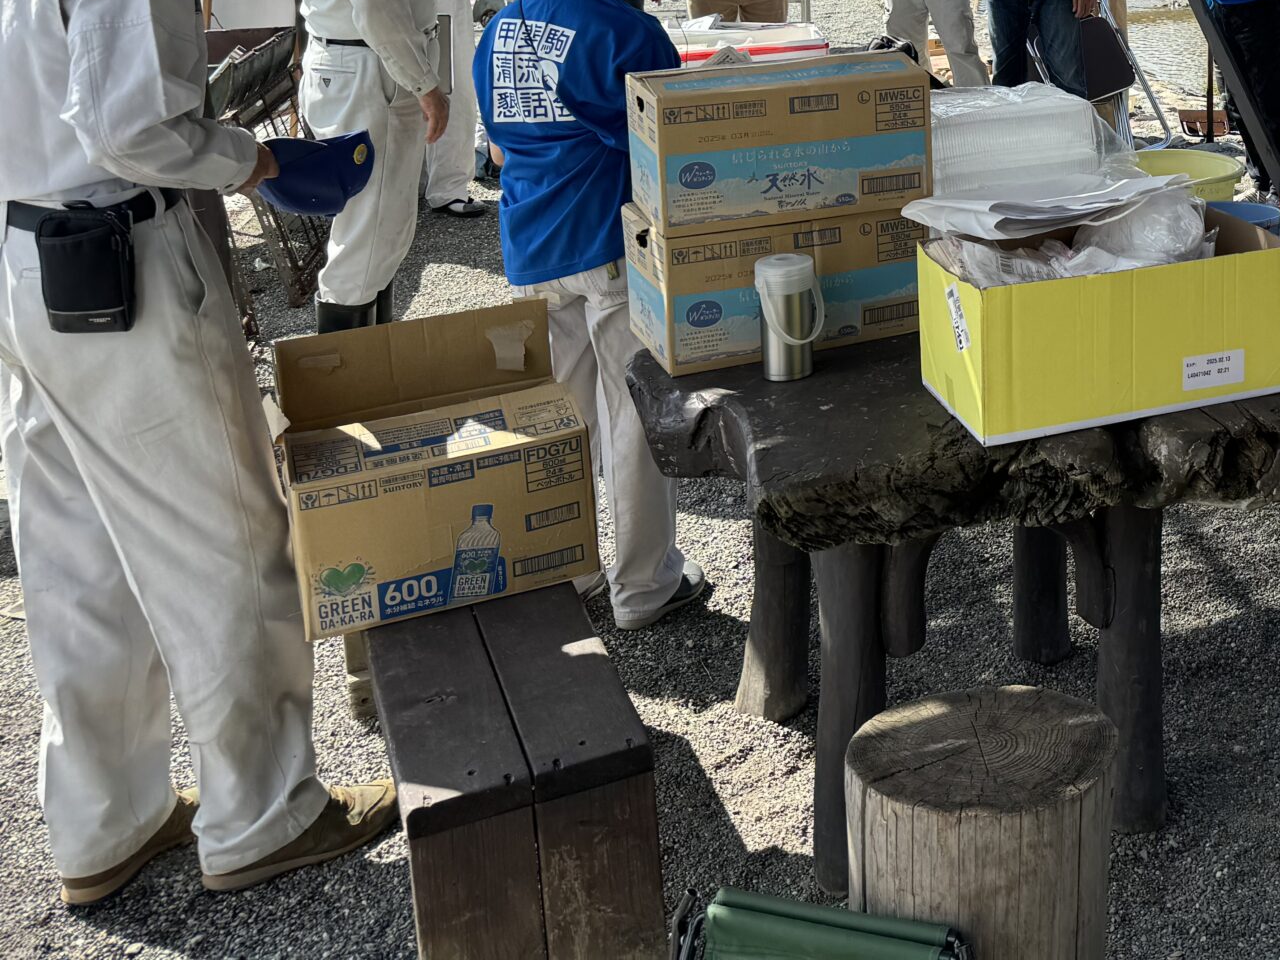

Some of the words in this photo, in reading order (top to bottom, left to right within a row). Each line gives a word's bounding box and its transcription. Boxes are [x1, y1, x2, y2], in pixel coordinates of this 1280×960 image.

[498, 22, 571, 58] 甲斐駒
[496, 56, 540, 84] 清流
[879, 89, 920, 103] MW5LC
[884, 119, 918, 128] ペットボトル
[732, 141, 851, 164] 信じられる水の山から
[760, 168, 824, 194] 天然水
[526, 439, 580, 462] FDG7U
[536, 473, 576, 488] ペットボトル
[545, 468, 564, 476] 24本
[384, 481, 424, 494] SUNTORY
[458, 576, 486, 586] GREEN
[318, 595, 372, 620] GREEN
[385, 601, 416, 615] 水分補給
[417, 596, 444, 608] ミネラル
